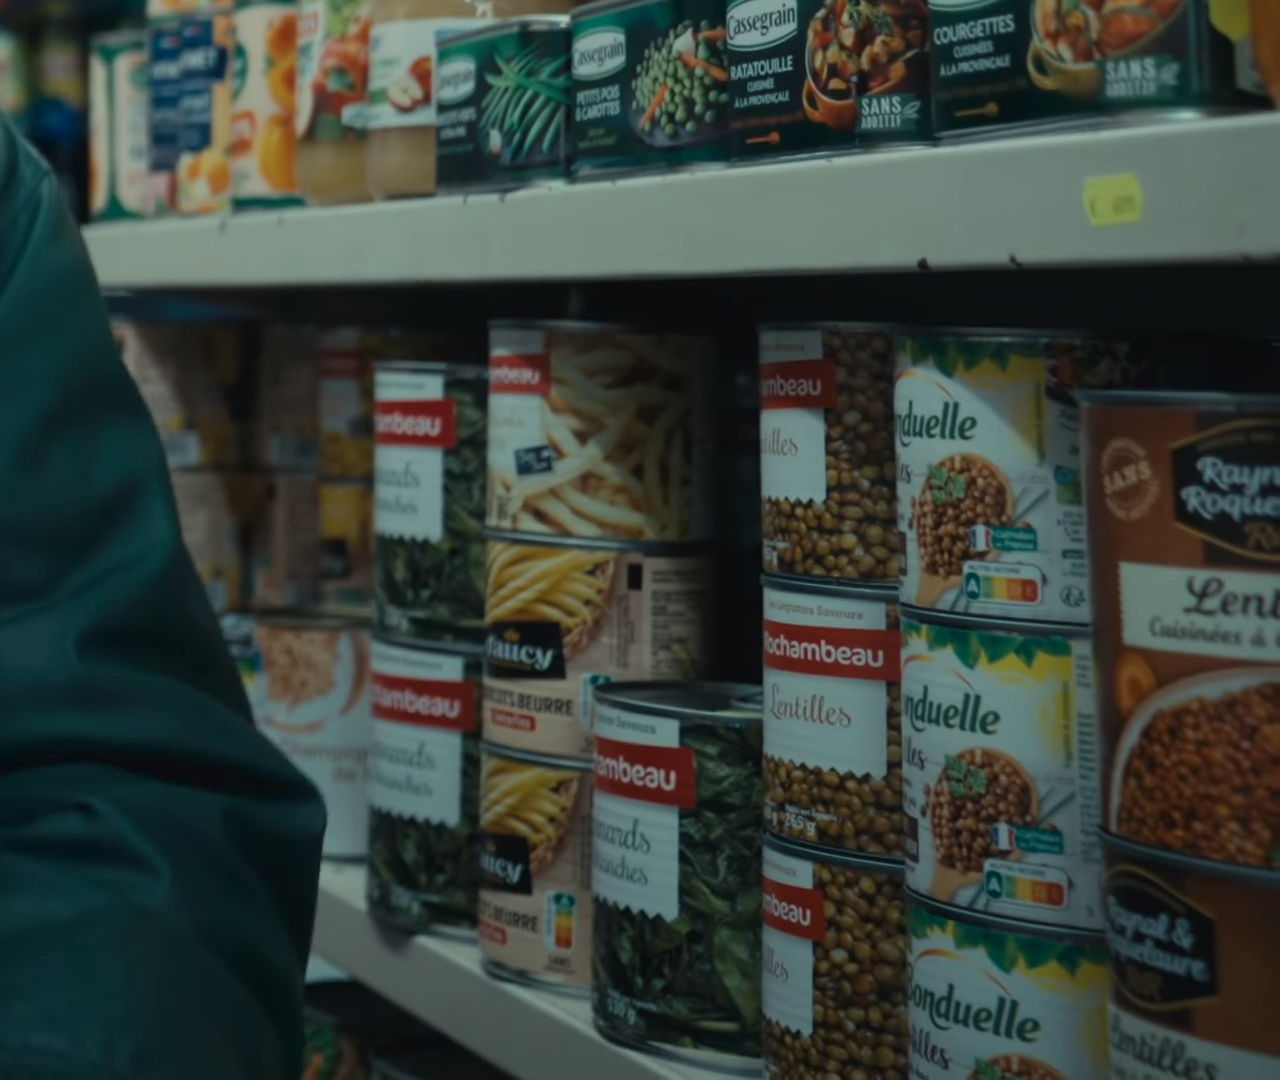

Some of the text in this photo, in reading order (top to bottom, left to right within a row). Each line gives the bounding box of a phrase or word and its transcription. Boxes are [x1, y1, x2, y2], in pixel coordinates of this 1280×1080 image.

[727, 3, 796, 40] Cassegrain
[933, 14, 1015, 45] COURGETTES
[729, 55, 794, 81] RATATOUILLE
[1105, 57, 1156, 81] SANS
[861, 96, 902, 115] SANS
[375, 410, 442, 438] mbeau
[372, 683, 461, 719] ambeau
[517, 693, 574, 718] BEURRE
[770, 683, 852, 728] Lentilles
[597, 854, 649, 887] anches
